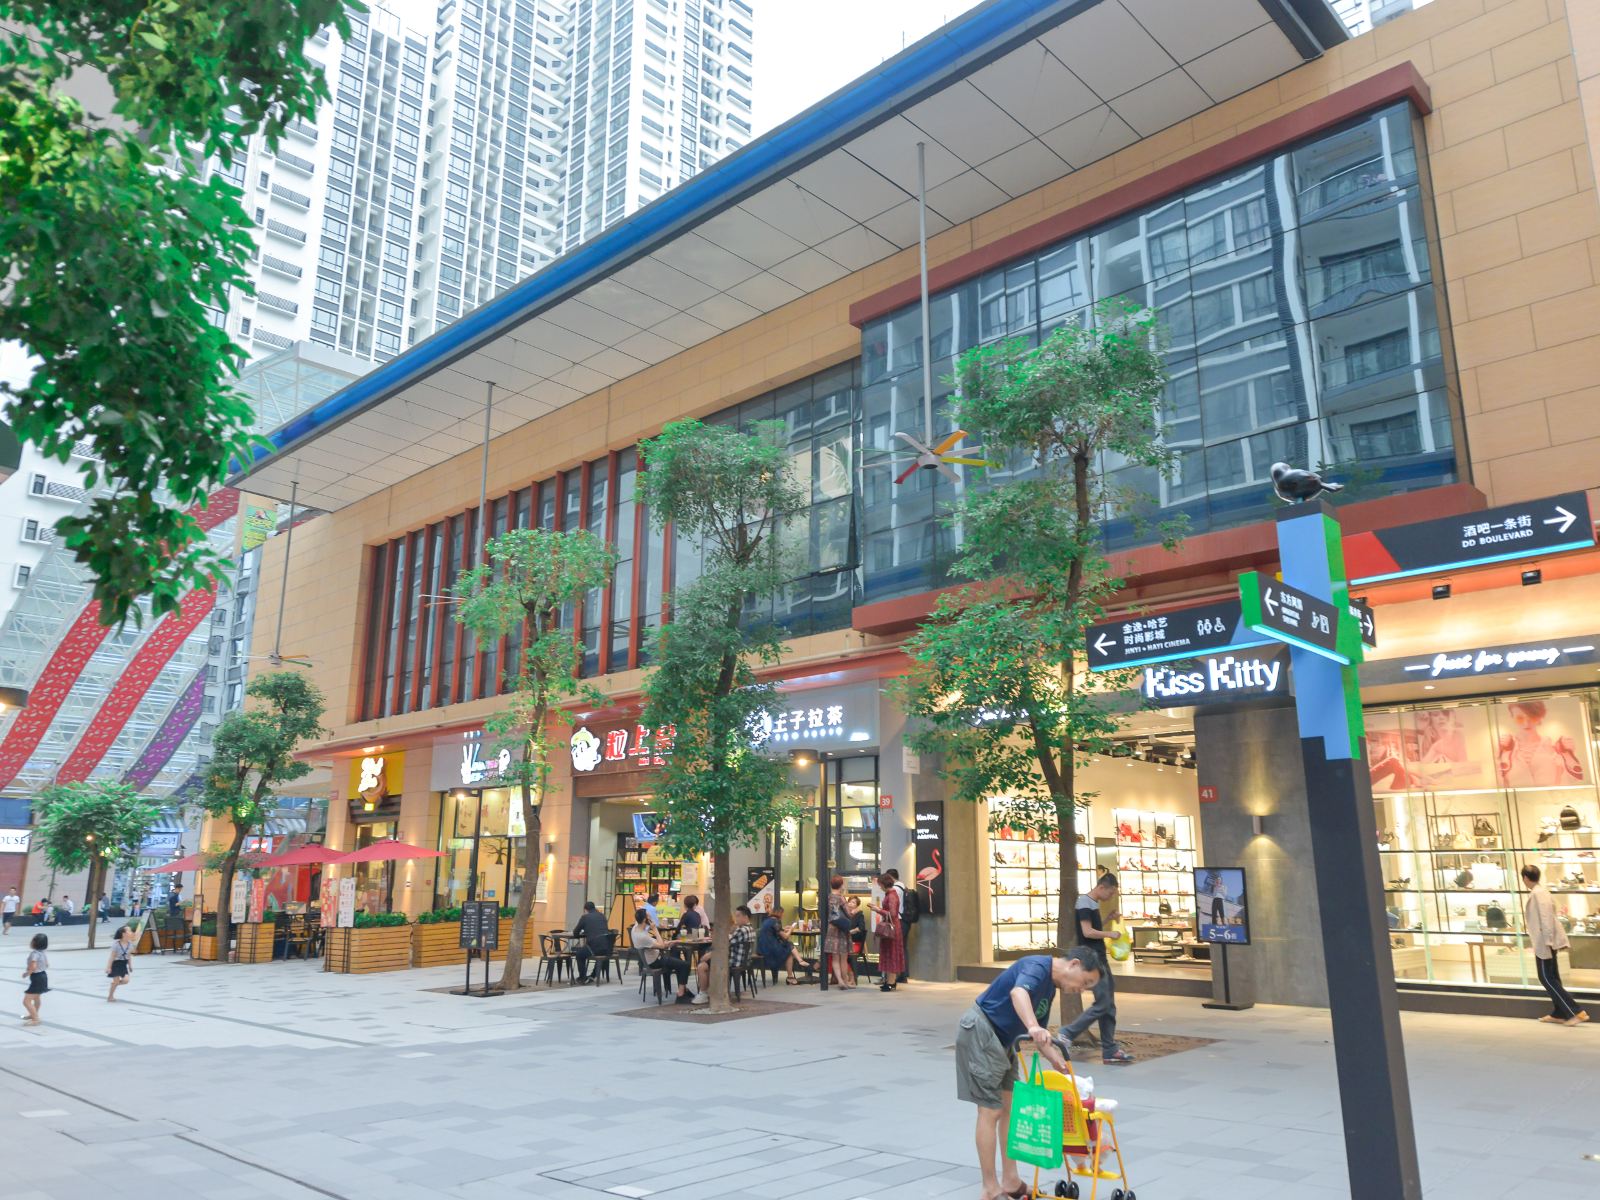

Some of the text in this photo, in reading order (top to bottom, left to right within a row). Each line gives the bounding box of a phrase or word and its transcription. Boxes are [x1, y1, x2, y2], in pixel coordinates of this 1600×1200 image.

[1463, 515, 1532, 537] 酒吧一条街
[1461, 529, 1534, 548] DD BOULEVARD
[1124, 629, 1166, 645] 时尚影城
[1147, 642, 1164, 651] HAYI
[1165, 638, 1191, 649] CINEMA
[1431, 647, 1561, 677] Just for young
[1146, 656, 1281, 698] Kiss Kitty
[882, 797, 891, 806] 39
[1202, 789, 1213, 798] 41
